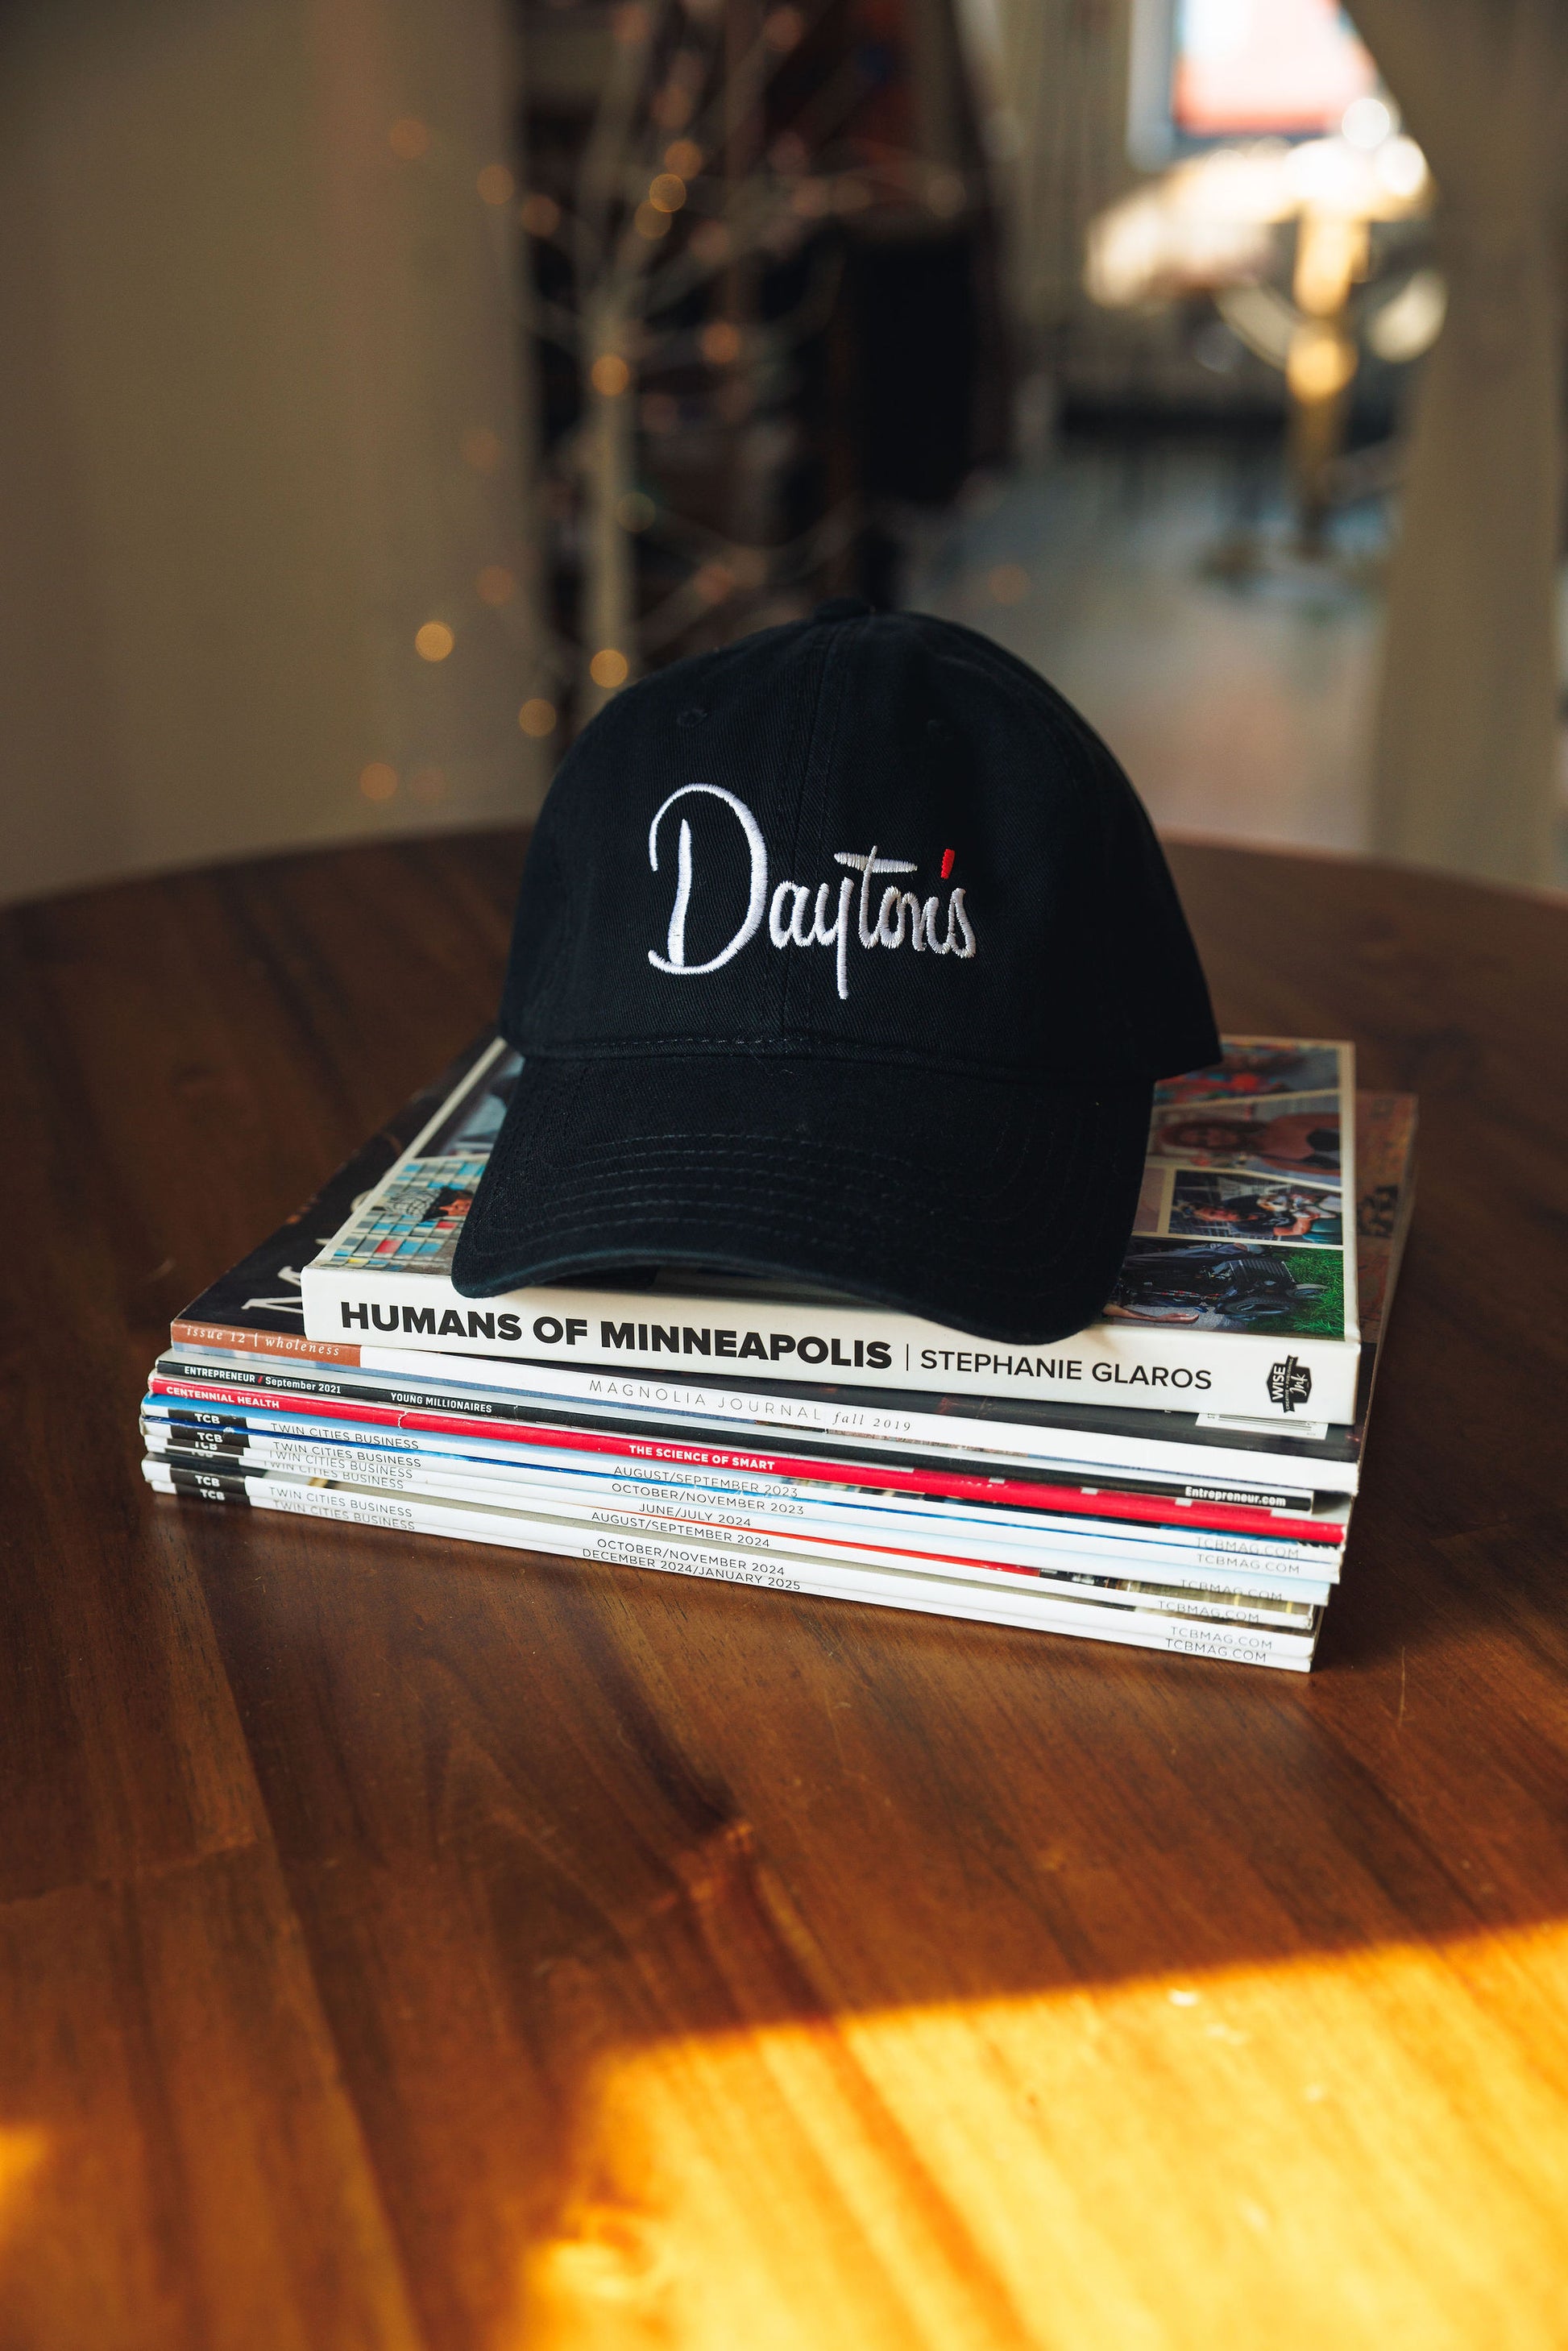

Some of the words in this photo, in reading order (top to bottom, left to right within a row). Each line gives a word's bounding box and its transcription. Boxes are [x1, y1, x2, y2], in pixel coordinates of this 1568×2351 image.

[648, 782, 977, 1000] Dayton's
[187, 1325, 222, 1340] issue
[230, 1333, 246, 1343] 12
[265, 1337, 340, 1356] wholeness
[341, 1301, 522, 1341] HUMANS
[533, 1316, 587, 1346] OF
[600, 1321, 893, 1370] MINNEAPOLIS
[185, 1366, 255, 1383] ENTREPRENEUR
[265, 1377, 317, 1392] September
[318, 1383, 342, 1394] 2021
[920, 1349, 1082, 1381] STEPHANIE
[1092, 1362, 1213, 1390] GLAROS
[1271, 1365, 1286, 1400] WISE
[166, 1386, 234, 1403] CENTENNIAL
[237, 1395, 280, 1409] HEALTH
[391, 1392, 423, 1405] YOUNG
[425, 1397, 492, 1413] MILLIONAIRES
[589, 1379, 706, 1406] MAGNOLIA
[718, 1398, 822, 1420] JOURNAL
[832, 1411, 864, 1426] fall
[873, 1416, 911, 1432] 2019
[194, 1413, 220, 1424] TCB
[197, 1432, 223, 1443] TCB
[271, 1423, 305, 1435] TWIN
[310, 1428, 350, 1441] CITIES
[355, 1433, 419, 1449] BUSINESS
[270, 1450, 301, 1462] TWIN
[305, 1455, 345, 1469] CITIES
[351, 1461, 413, 1478] BUSINESS
[273, 1441, 307, 1453] TWIN
[312, 1446, 352, 1459] CITIES
[358, 1452, 421, 1467] BUSINESS
[629, 1445, 652, 1455] THE
[656, 1448, 708, 1463] SCIENCE
[711, 1454, 728, 1465] OF
[732, 1457, 775, 1470] SMART
[195, 1475, 220, 1487] TCB
[200, 1489, 225, 1500] TCB
[614, 1466, 759, 1493] AUGUST/SEPTEMBER
[765, 1484, 798, 1498] 2023
[270, 1486, 301, 1499] TWIN
[307, 1493, 346, 1507] CITIES
[351, 1500, 412, 1517] BUSINESS
[612, 1483, 765, 1511] OCTOBER/NOVEMBER
[770, 1503, 803, 1515] 2023
[1184, 1486, 1287, 1507] Entrepreneur.com
[273, 1499, 305, 1513] TWIN
[311, 1506, 349, 1520] CITIES
[355, 1513, 415, 1530] BUSINESS
[639, 1503, 712, 1522] JUNE/JULY
[718, 1514, 751, 1527] 2024
[591, 1511, 732, 1542] AUGUST/SEPTEMBER
[737, 1534, 769, 1548] 2024
[583, 1548, 655, 1568] DECEMBER
[661, 1560, 763, 1584] 2024/JANUARY
[768, 1577, 801, 1590] 2025
[597, 1538, 746, 1569] OCTOBER/NOVEMBER
[751, 1562, 784, 1575] 2024
[1197, 1553, 1300, 1574] TCBMAG.COM
[1158, 1600, 1259, 1623] TCBMAG.COM
[1165, 1638, 1267, 1662] TCBMAG.COM
[1170, 1625, 1272, 1649] TCBMAG.COM
